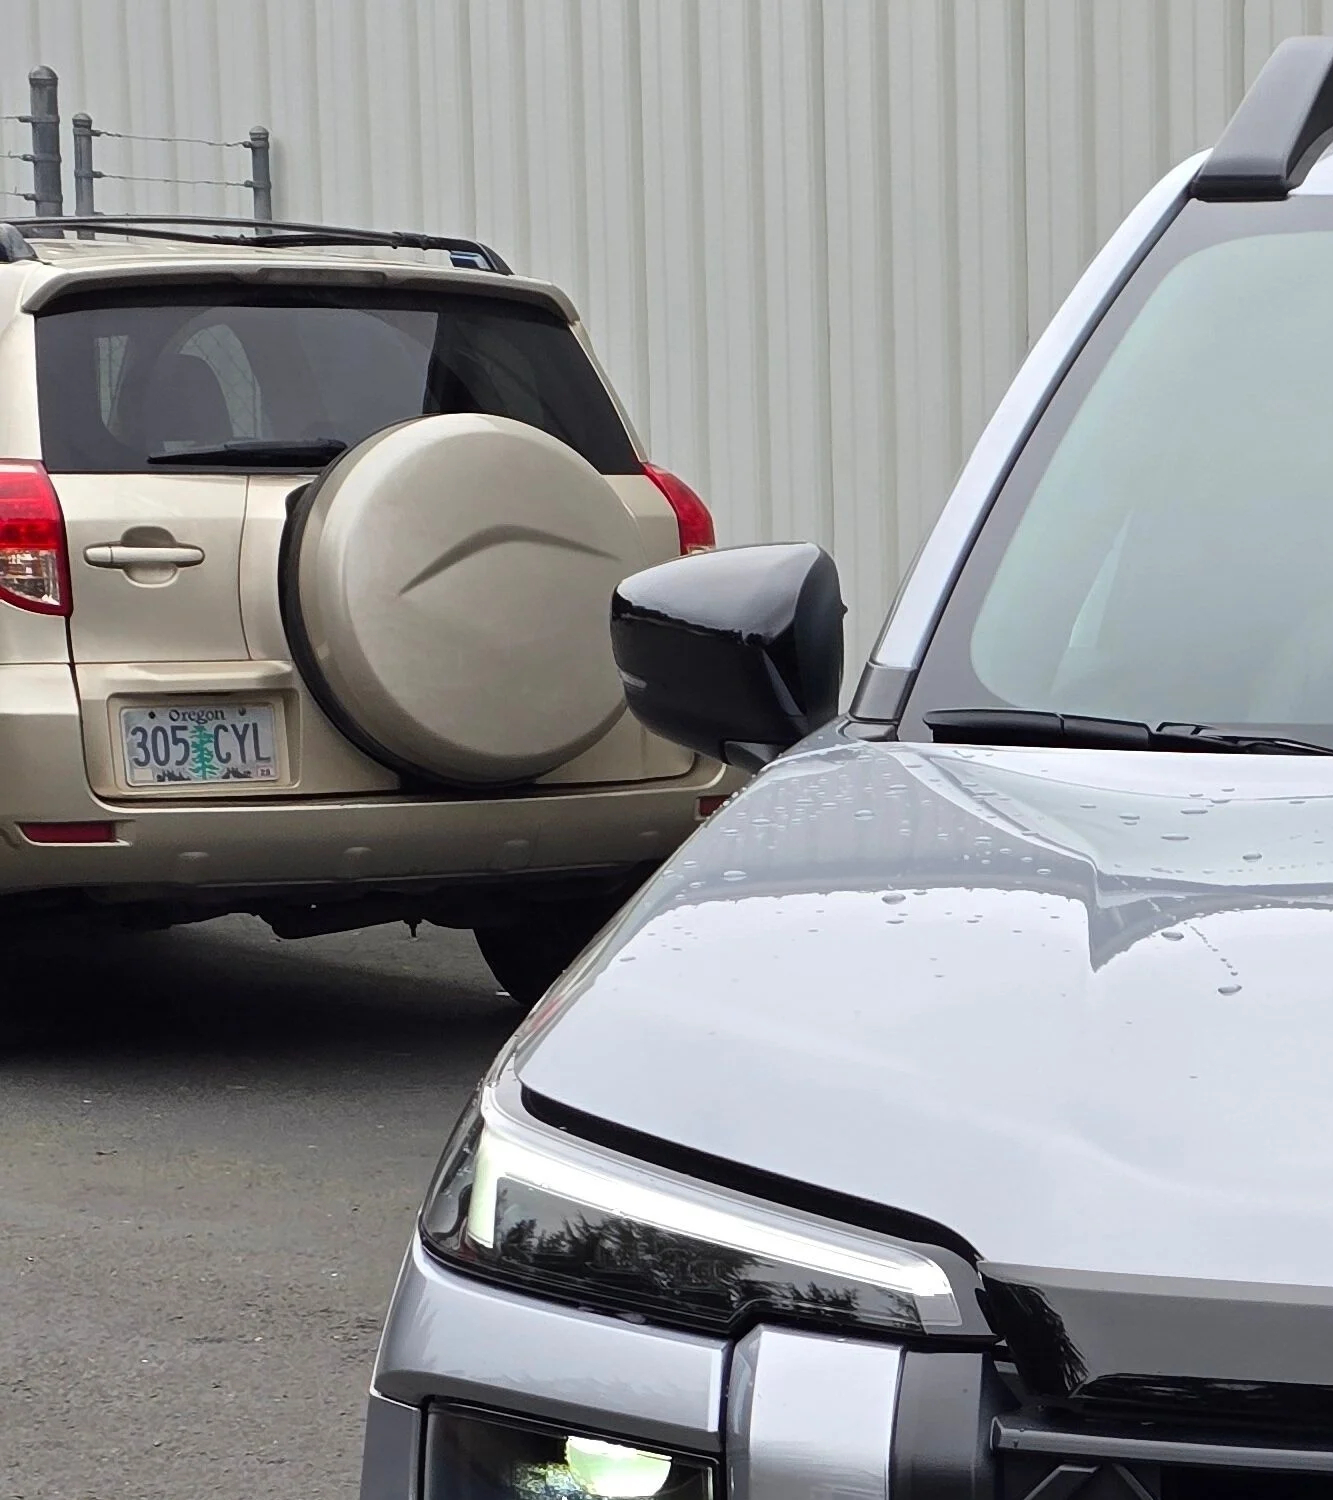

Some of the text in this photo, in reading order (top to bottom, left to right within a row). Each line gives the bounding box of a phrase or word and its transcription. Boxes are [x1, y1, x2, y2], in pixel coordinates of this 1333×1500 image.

[168, 708, 226, 725] Oregon
[130, 722, 271, 767] 305 CYL
